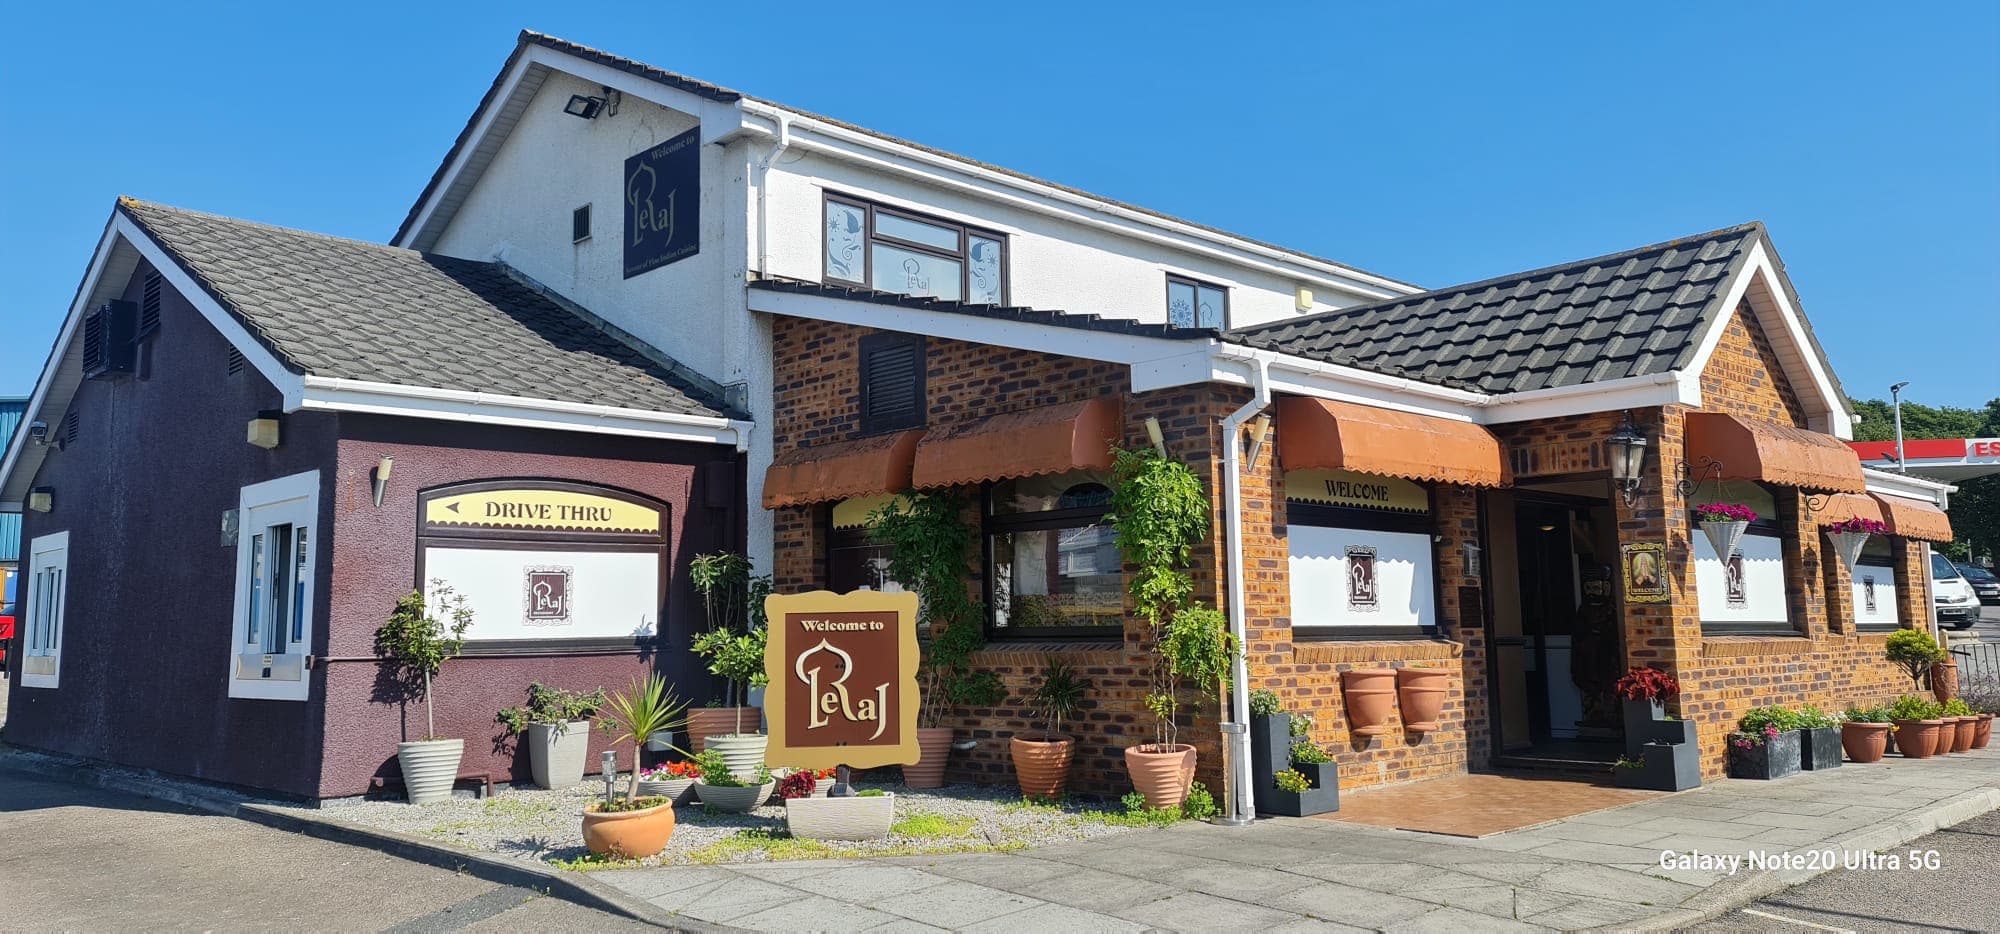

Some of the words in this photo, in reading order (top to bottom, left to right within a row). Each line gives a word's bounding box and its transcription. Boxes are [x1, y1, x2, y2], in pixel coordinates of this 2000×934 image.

[651, 141, 686, 160] Welcome
[687, 135, 695, 145] to
[1325, 479, 1389, 501] WELCOME
[485, 501, 552, 520] DRIVE
[557, 504, 612, 522] THRU
[801, 619, 867, 632] Welcome
[869, 620, 885, 631] to
